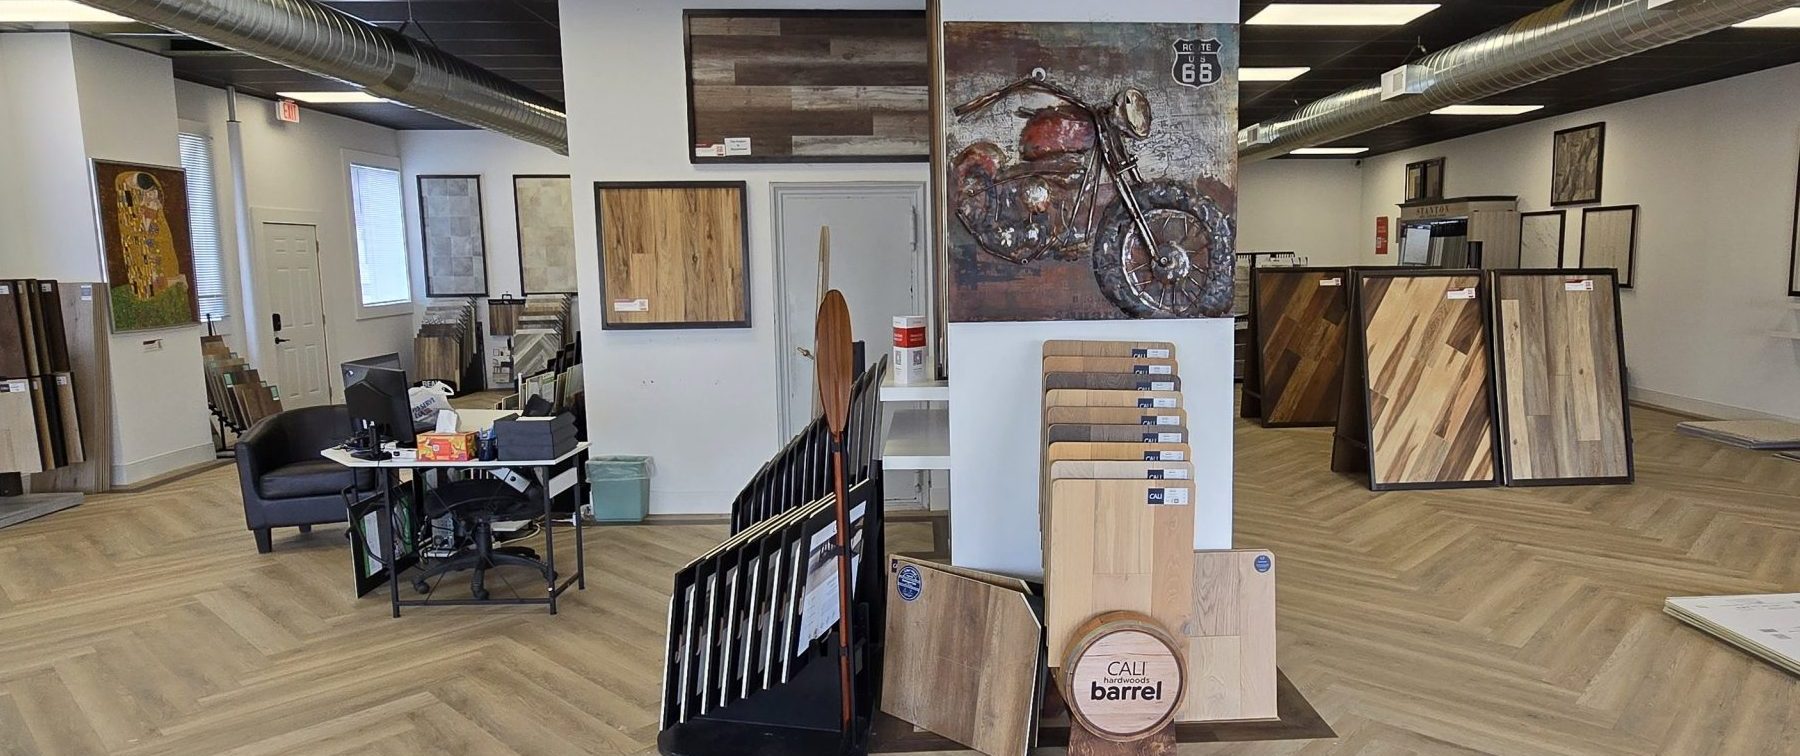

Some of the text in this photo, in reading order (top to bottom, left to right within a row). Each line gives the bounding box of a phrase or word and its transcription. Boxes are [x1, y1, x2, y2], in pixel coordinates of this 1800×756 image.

[1182, 43, 1212, 51] ROTE
[1182, 63, 1212, 82] 66
[283, 102, 297, 121] EXIT
[1416, 205, 1449, 216] STANTON
[1107, 661, 1147, 676] CALI
[1103, 676, 1150, 684] hardwoods
[1090, 680, 1162, 700] barrel
